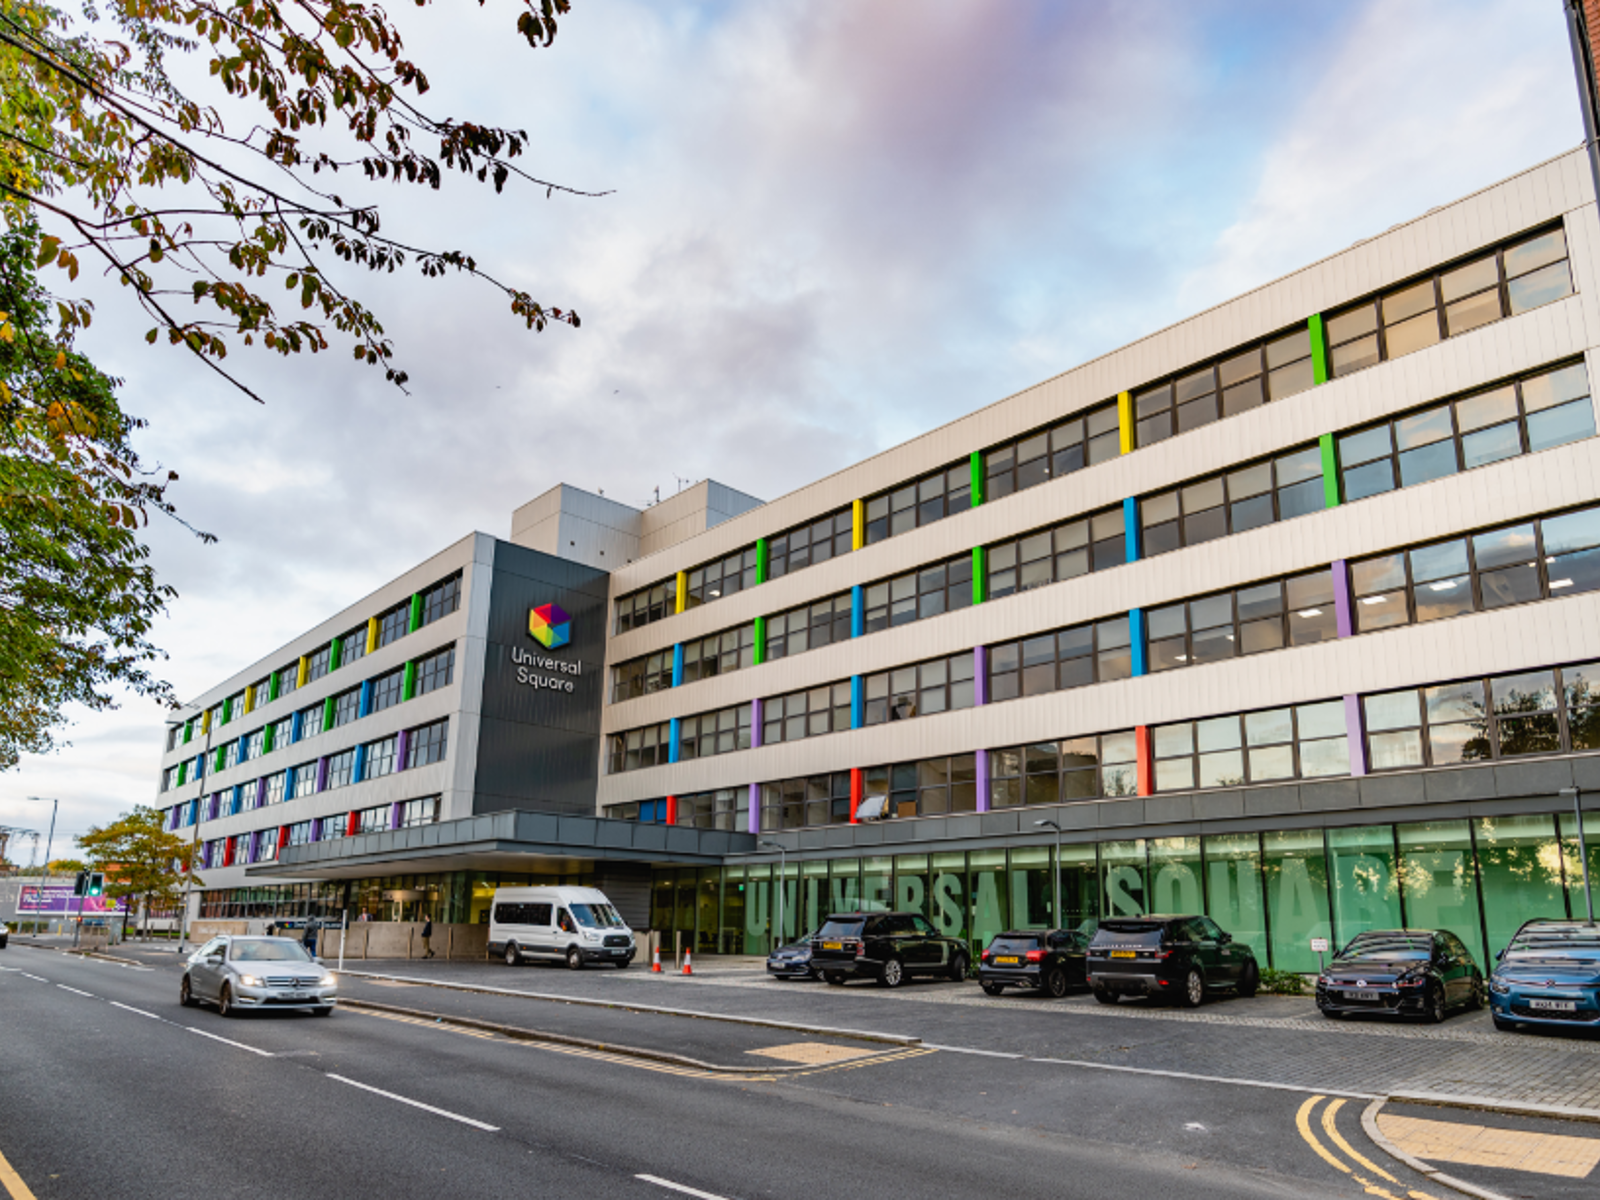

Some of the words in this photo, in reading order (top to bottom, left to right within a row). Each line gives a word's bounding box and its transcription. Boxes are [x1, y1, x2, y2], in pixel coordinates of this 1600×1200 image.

[511, 646, 581, 675] Universal
[516, 666, 574, 693] Square
[746, 869, 1049, 940] UNIVERSAL
[1105, 851, 1474, 940] SQUARE
